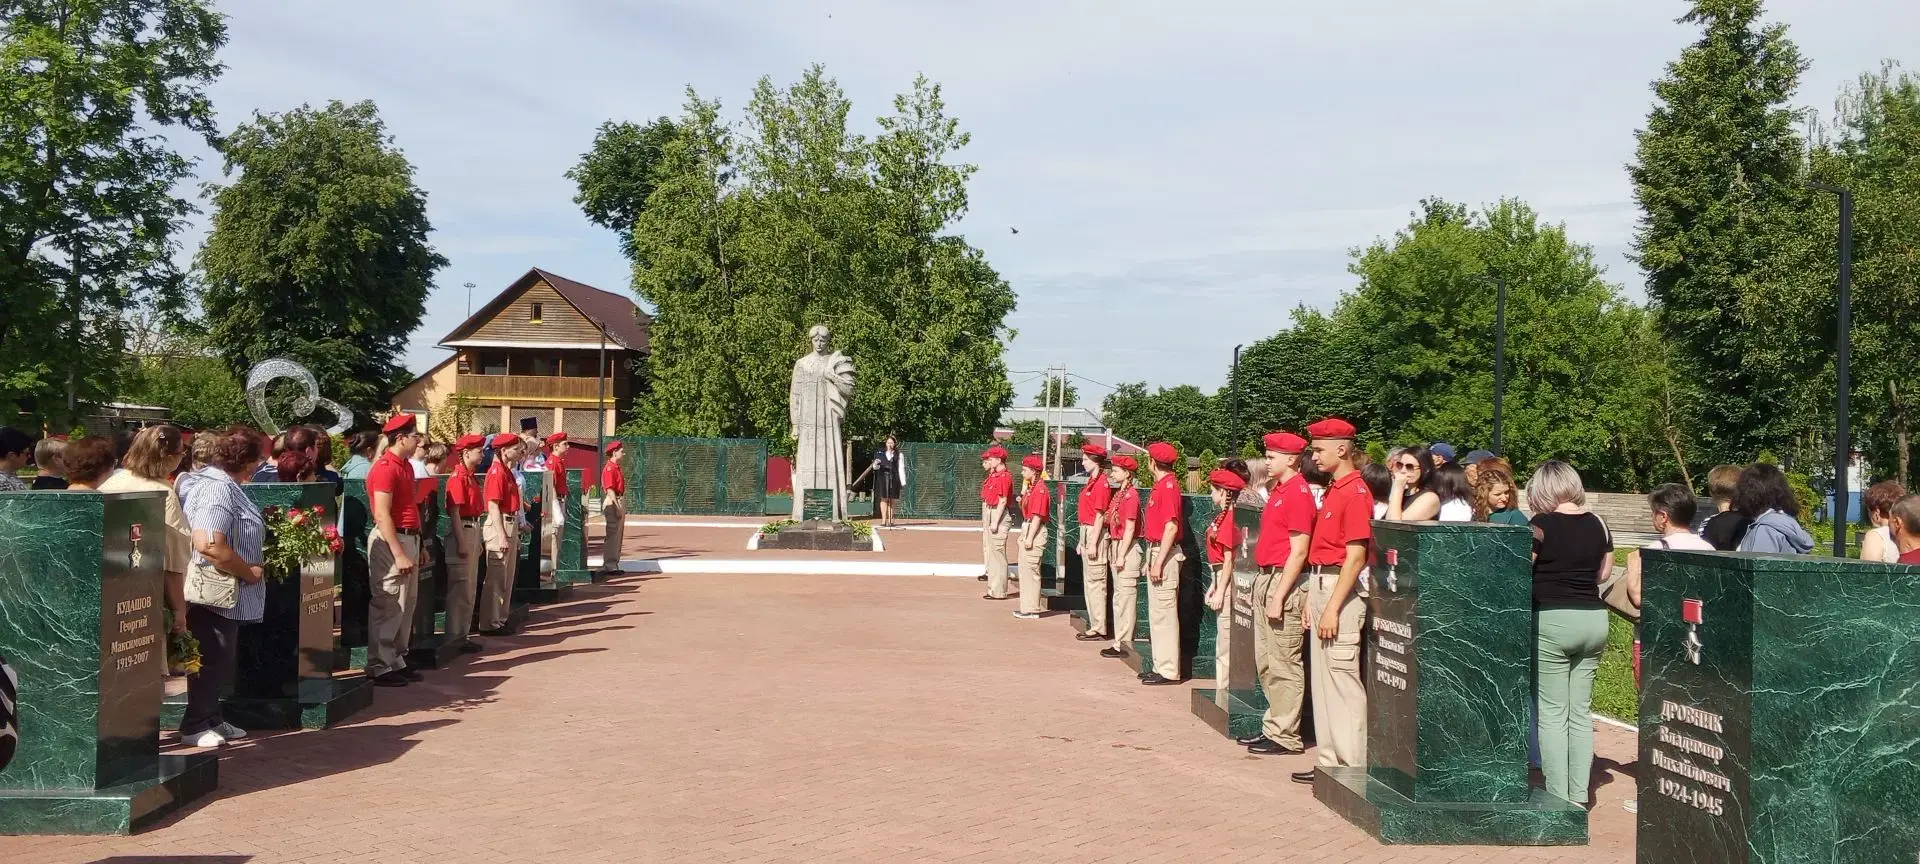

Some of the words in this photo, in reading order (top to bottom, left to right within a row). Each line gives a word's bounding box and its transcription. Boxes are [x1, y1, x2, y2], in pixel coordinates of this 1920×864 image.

[116, 596, 152, 616] КУДАШОВ
[119, 615, 148, 634] Георгий
[110, 634, 155, 655] Максимович
[116, 651, 149, 670] 1919-2007
[1661, 699, 1724, 734] ДРОВНИК
[1659, 725, 1724, 766] Владимир
[1652, 748, 1731, 793] Михайлович
[1658, 777, 1723, 817] 1924-1945
